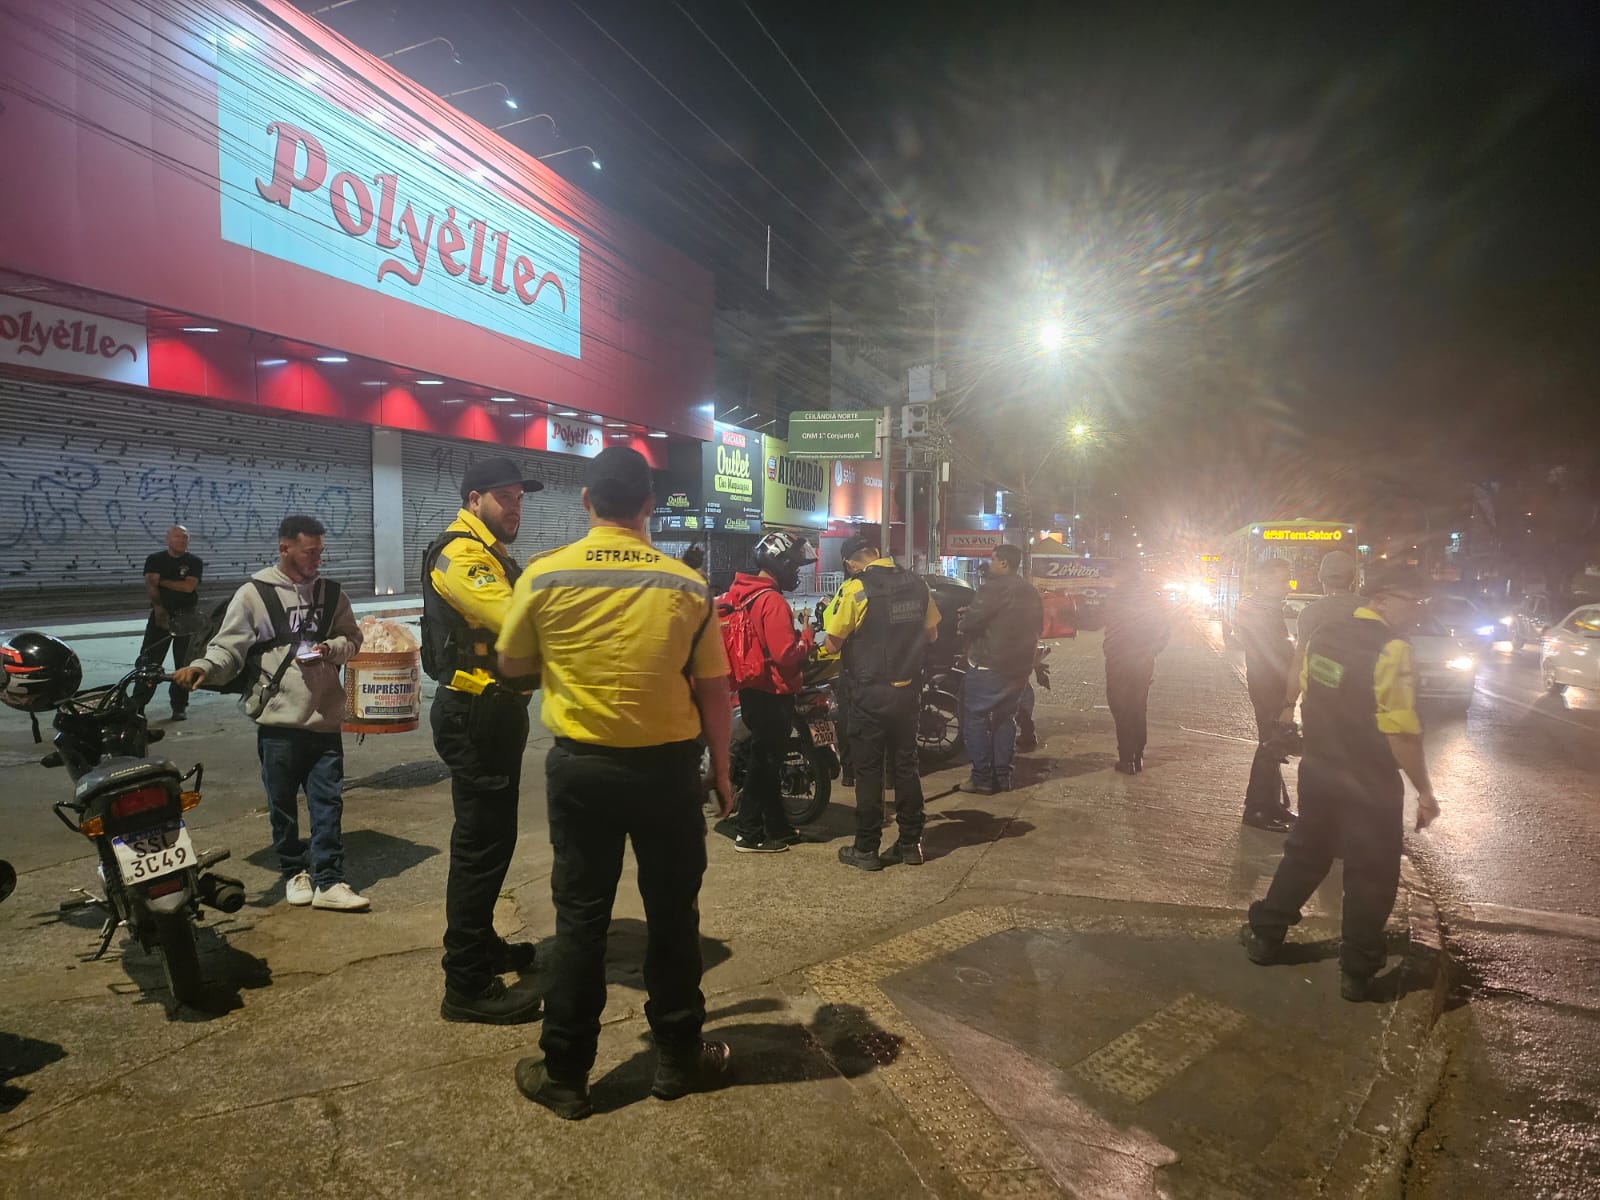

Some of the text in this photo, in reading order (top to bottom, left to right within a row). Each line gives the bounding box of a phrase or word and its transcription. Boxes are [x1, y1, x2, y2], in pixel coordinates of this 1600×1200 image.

[827, 432, 854, 441] Conjunto
[717, 445, 750, 478] Outlet
[586, 549, 661, 563] DETRAN-DF
[131, 847, 187, 878] 3C49
